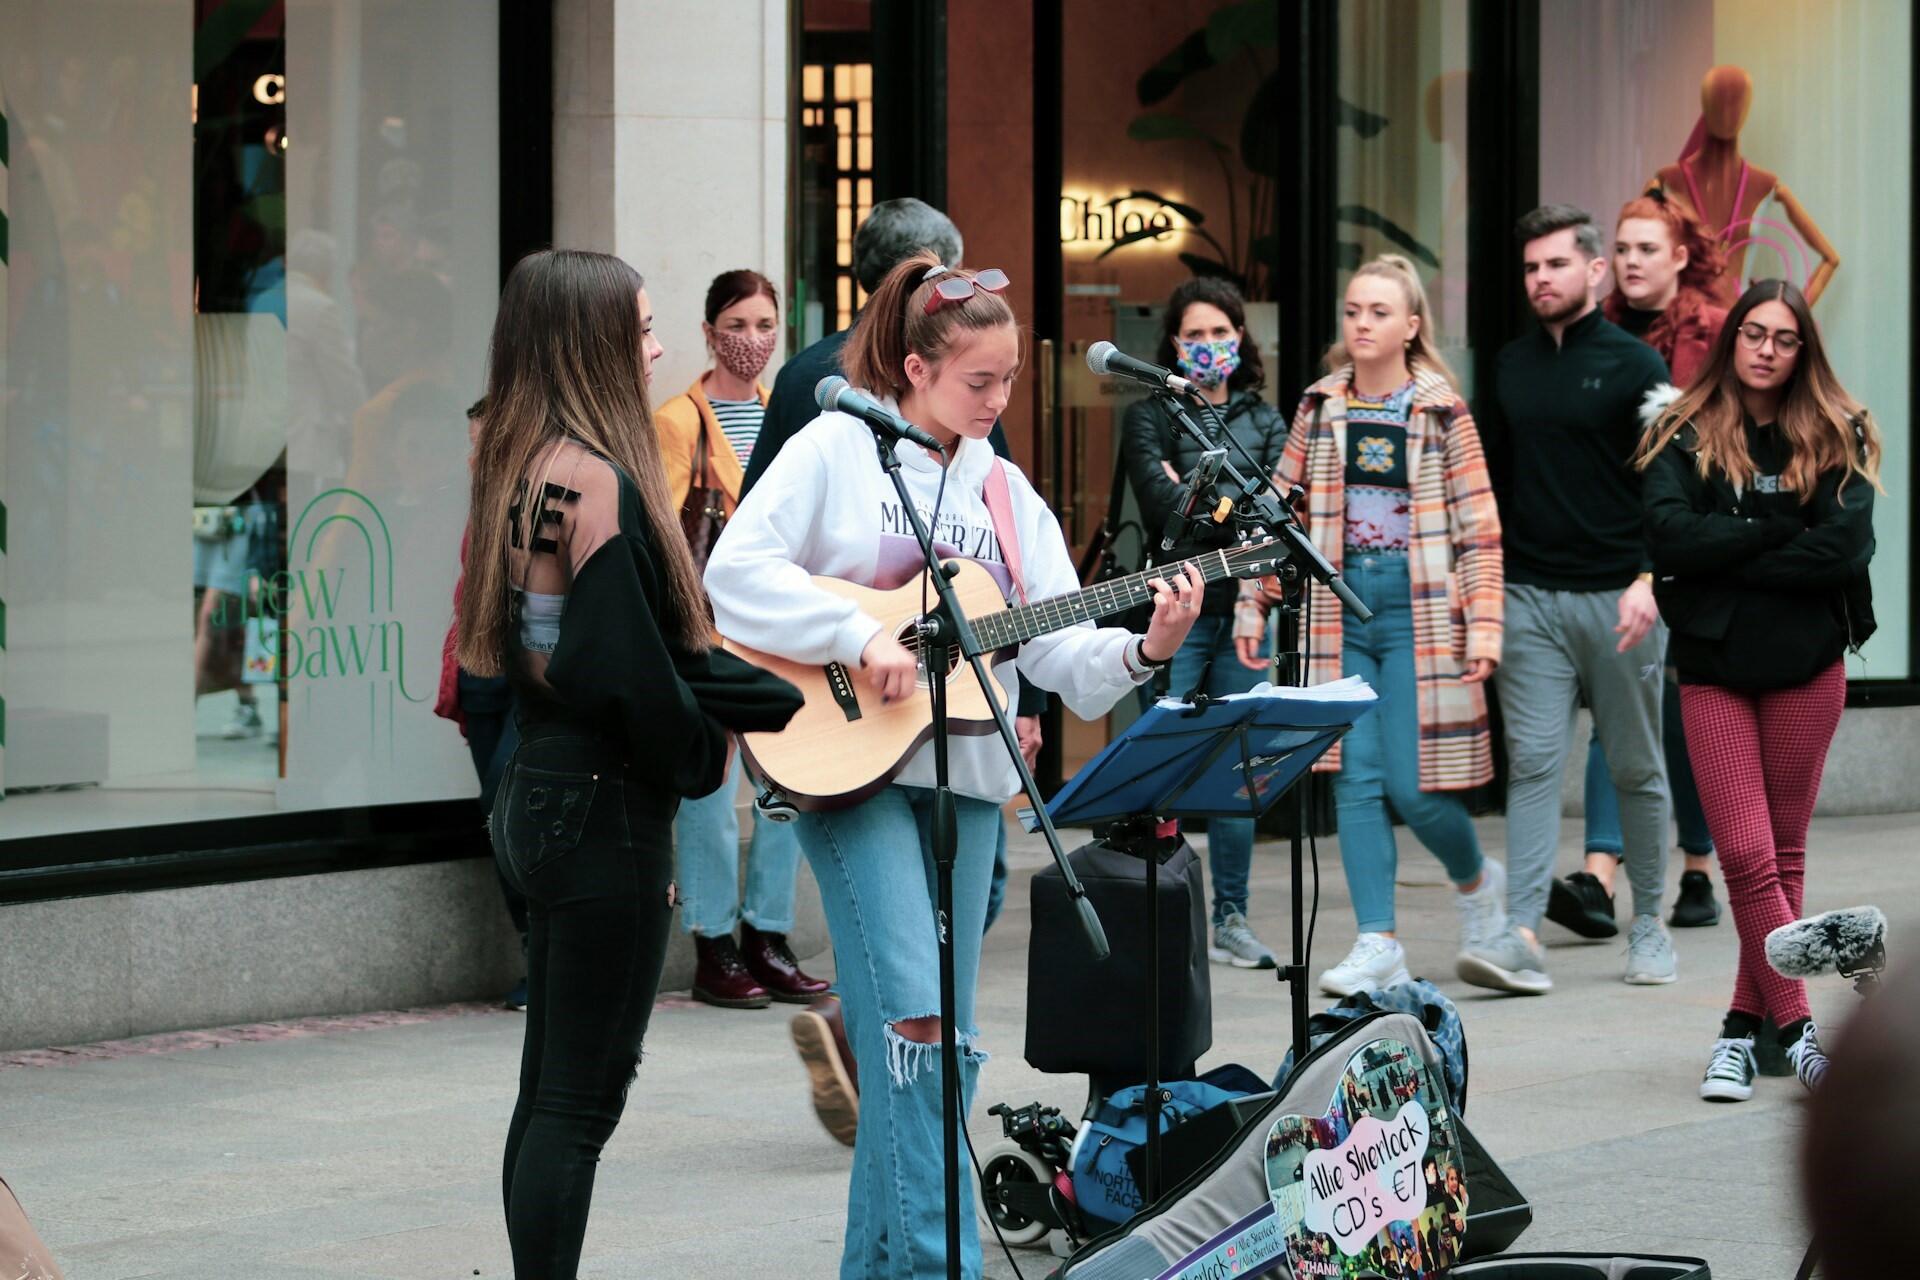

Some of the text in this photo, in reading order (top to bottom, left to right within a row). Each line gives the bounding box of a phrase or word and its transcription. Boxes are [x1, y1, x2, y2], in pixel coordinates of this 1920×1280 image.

[240, 567, 344, 656] new
[1309, 1115, 1424, 1203] Allie Sherlock
[1105, 1188, 1142, 1209] FACE
[1332, 1160, 1418, 1237] CD's €7
[1303, 1261, 1340, 1277] THANK
